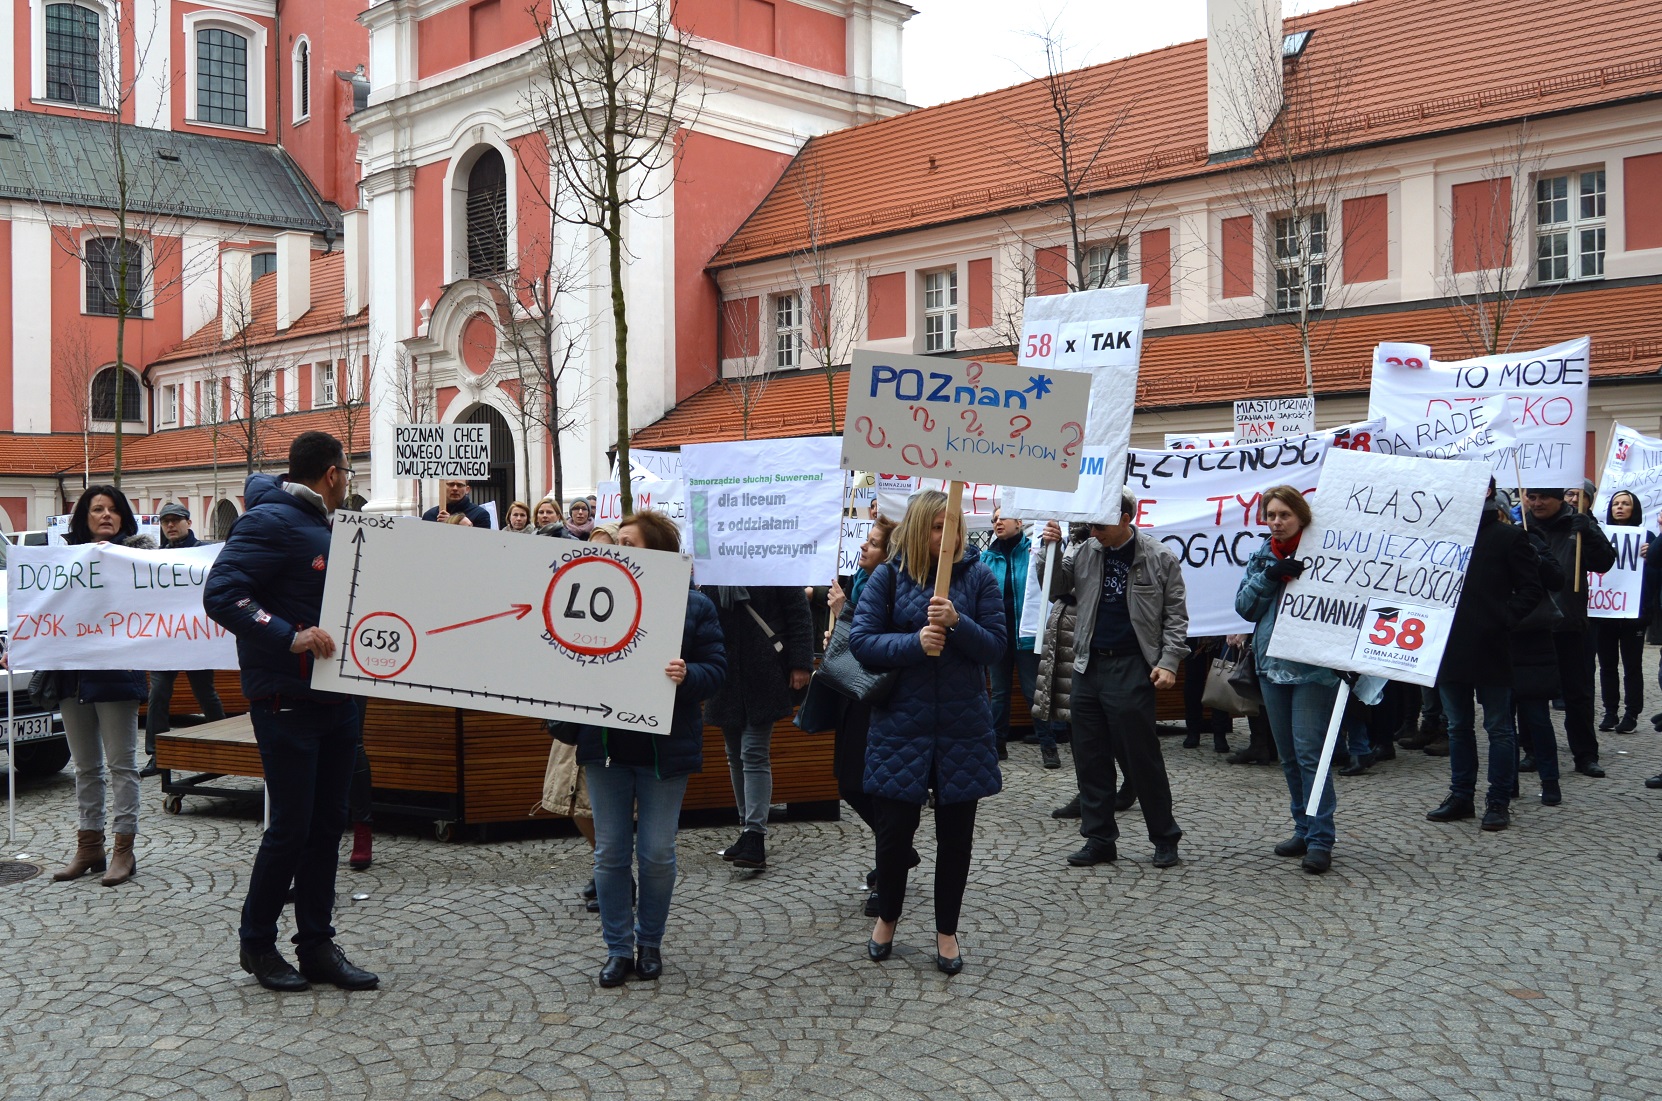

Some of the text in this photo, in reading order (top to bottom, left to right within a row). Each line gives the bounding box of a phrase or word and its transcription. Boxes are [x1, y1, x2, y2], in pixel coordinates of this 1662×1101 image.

[1024, 330, 1132, 358] 58 x TAK
[1451, 357, 1585, 388] TO MOJE
[1236, 398, 1314, 415] MIASTO POZNAŃ
[1236, 414, 1263, 422] STAWIA
[396, 426, 484, 443] POZNAŃ CHCE
[1237, 421, 1301, 438] TAK! DLA
[1333, 430, 1371, 452] 58
[1376, 432, 1411, 455] DA
[396, 444, 489, 460] NOWEGO LICEUM
[396, 460, 491, 480] DWUJĘZYCZNEGO!
[689, 472, 824, 488] Samorządzie słuchaj Suwerena!
[717, 491, 786, 507] dla liceum
[1345, 483, 1455, 527] KLASY
[337, 512, 395, 531] JAKOŚĆ
[717, 515, 799, 532] z oddziałami
[718, 540, 818, 560] dwujęzycznymi
[561, 547, 644, 580] ODDZIAŁAMI
[17, 561, 206, 591] DOBRE LICEU
[1104, 576, 1118, 588] 58
[1297, 555, 1465, 608] PRZYSZŁOŚCIĄ
[563, 582, 615, 623] LO
[12, 611, 227, 641] ZYSK DLA POZNANI
[1368, 616, 1426, 651] 58
[359, 627, 402, 653] G58
[571, 632, 608, 646] 2017
[364, 655, 397, 669] 1999
[1363, 647, 1419, 664] GIMNAZJUM
[616, 711, 660, 728] CZAS
